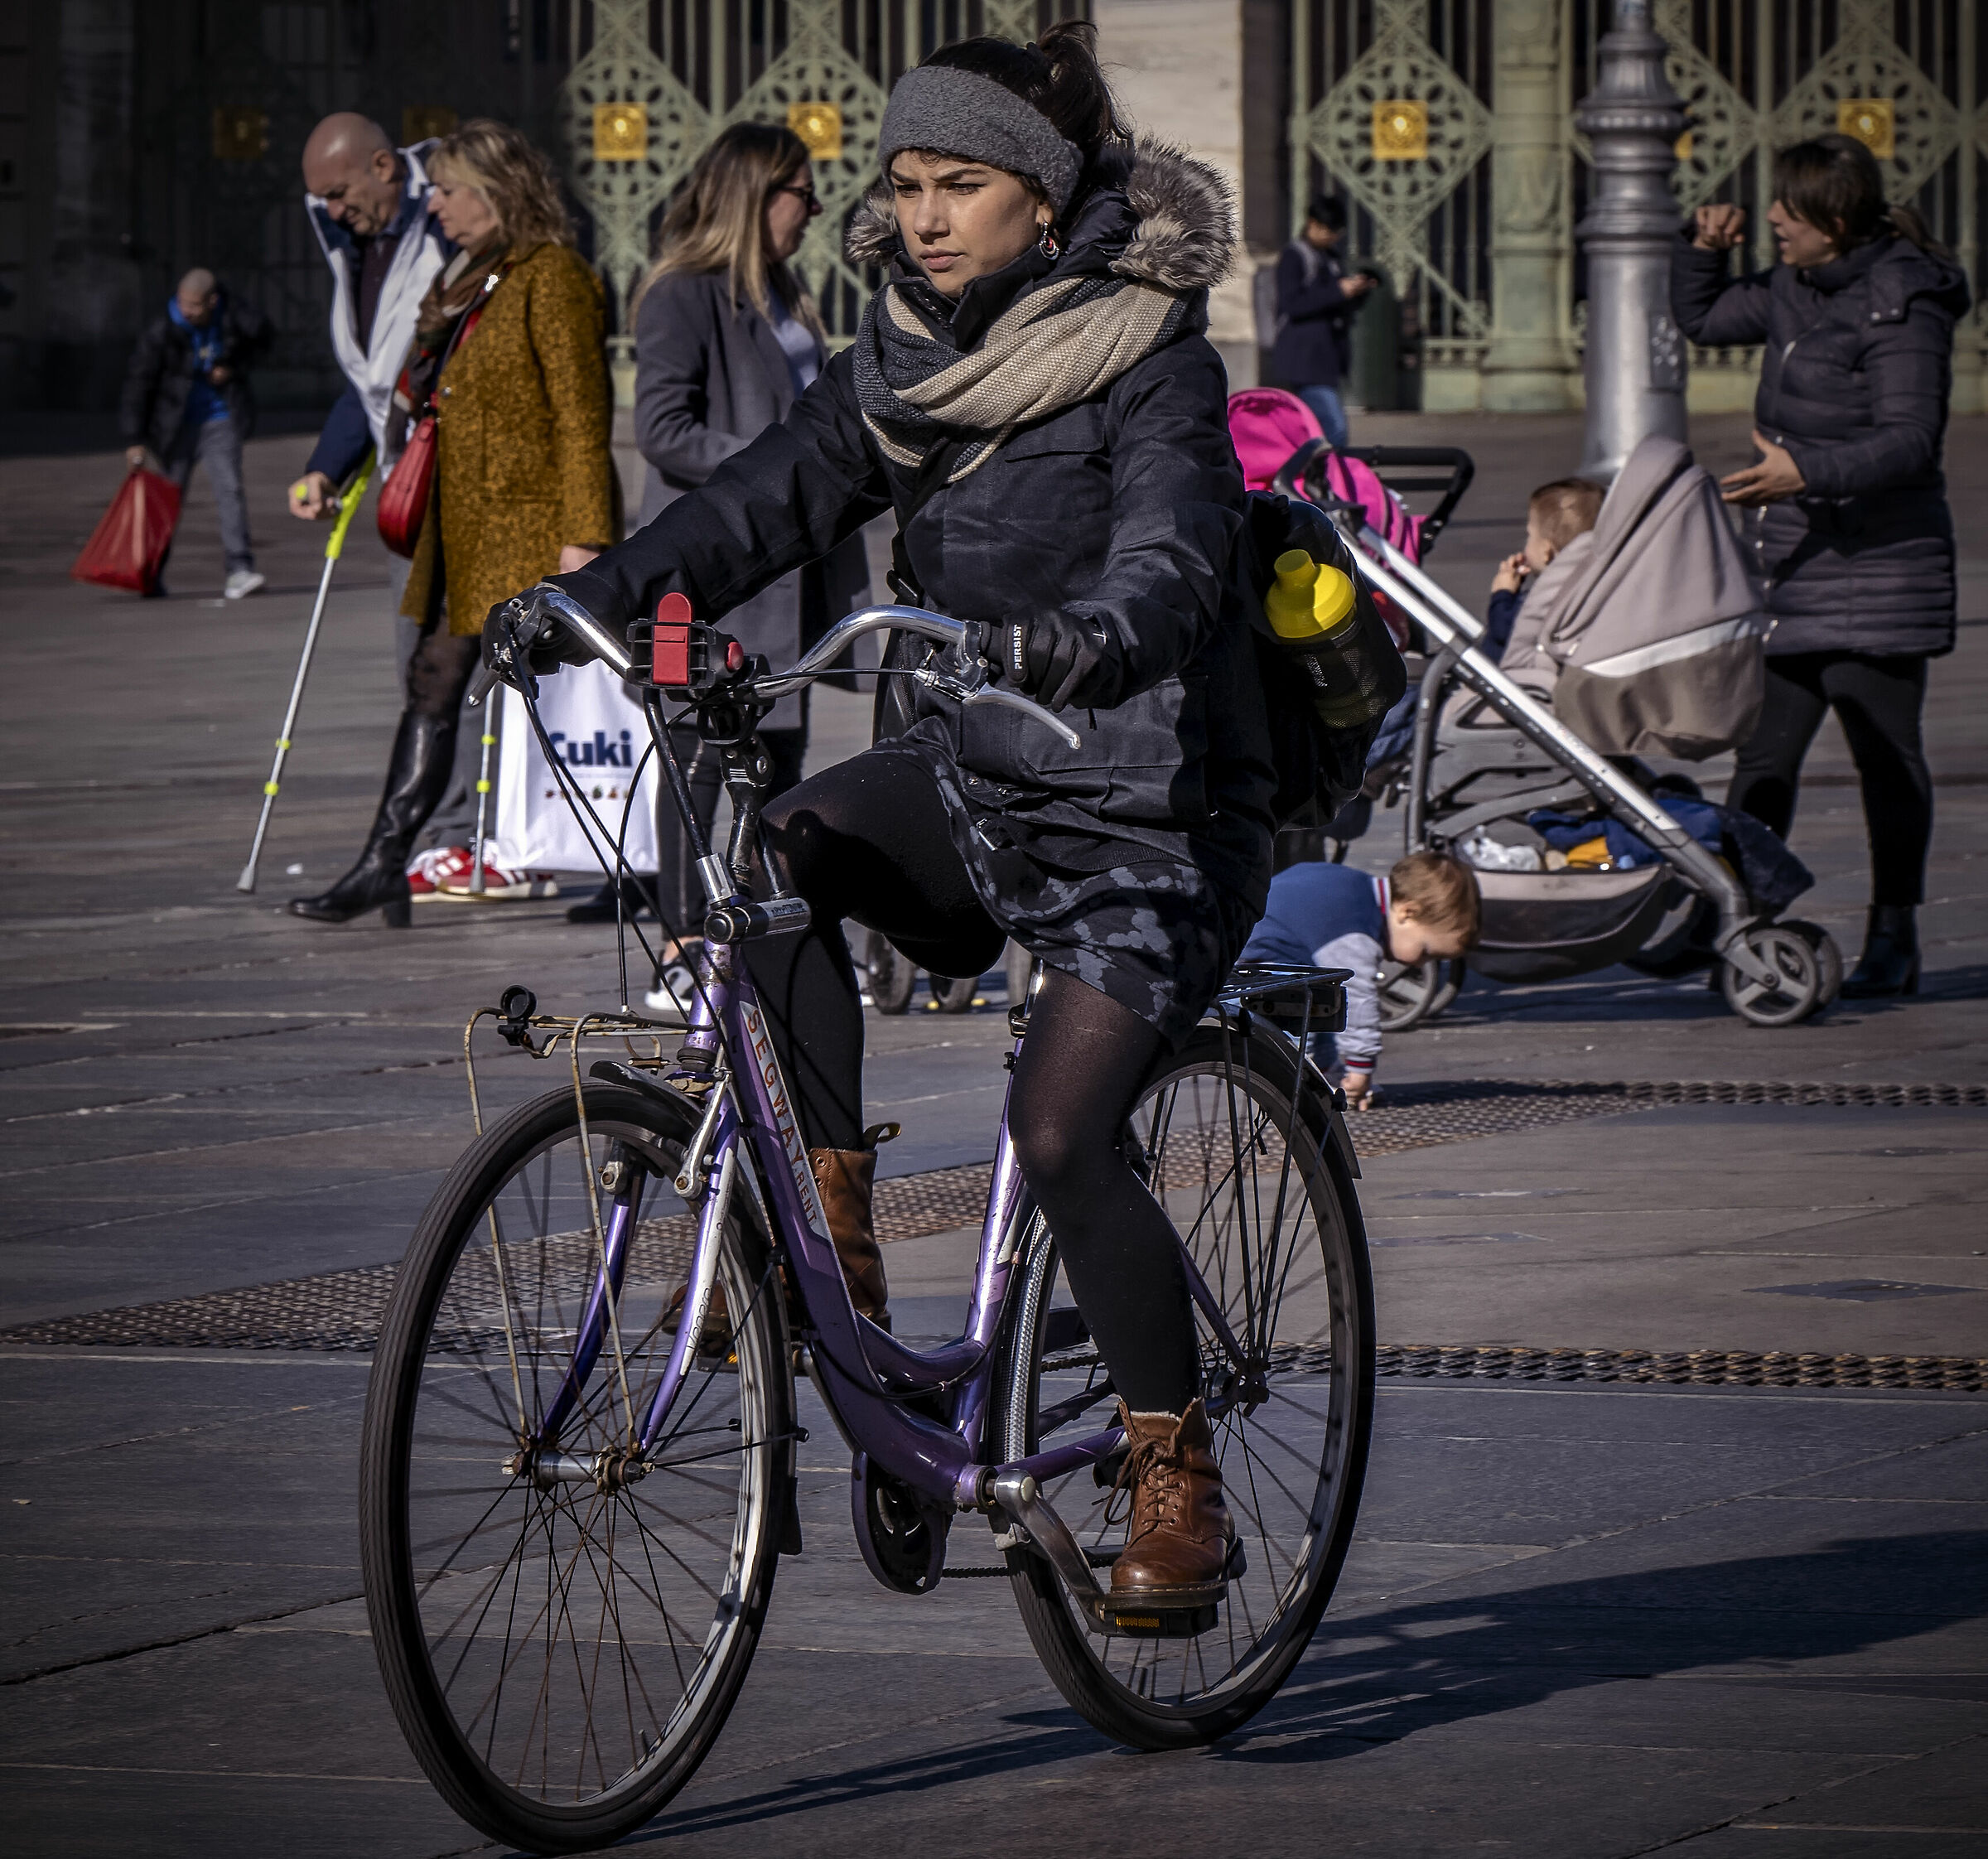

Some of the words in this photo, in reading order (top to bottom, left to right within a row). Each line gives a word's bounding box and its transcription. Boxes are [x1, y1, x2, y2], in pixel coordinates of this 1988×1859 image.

[1013, 624, 1022, 669] PERSIST
[548, 729, 632, 766] Cuki
[748, 1009, 803, 1166] SEGWAY
[796, 1171, 817, 1222] RENT
